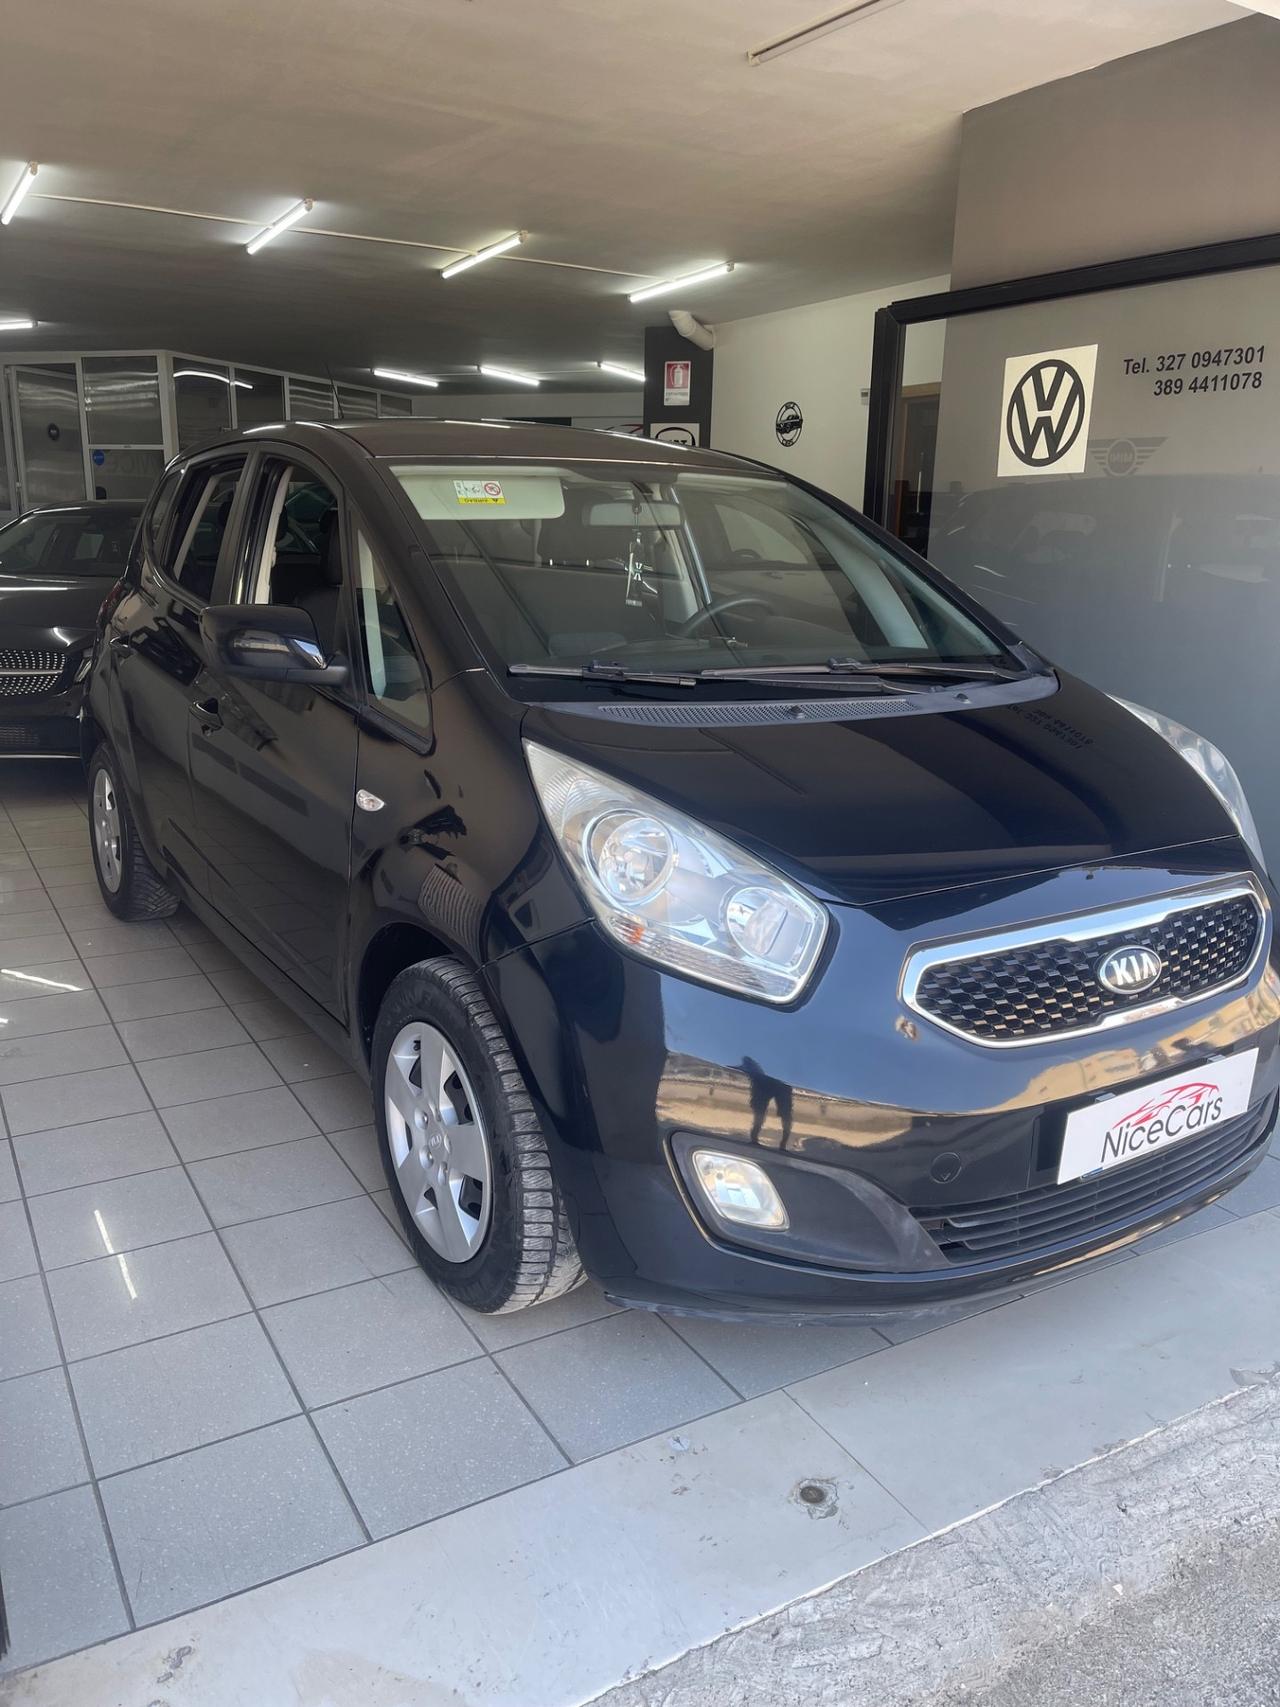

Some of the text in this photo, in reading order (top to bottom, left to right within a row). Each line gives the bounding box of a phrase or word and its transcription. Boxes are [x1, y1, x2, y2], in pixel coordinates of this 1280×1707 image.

[1123, 345, 1265, 375] Tel. 327 0947301
[1153, 371, 1263, 396] 389 4411078
[1110, 952, 1158, 986] KIA
[1100, 1096, 1223, 1163] NiceCars
